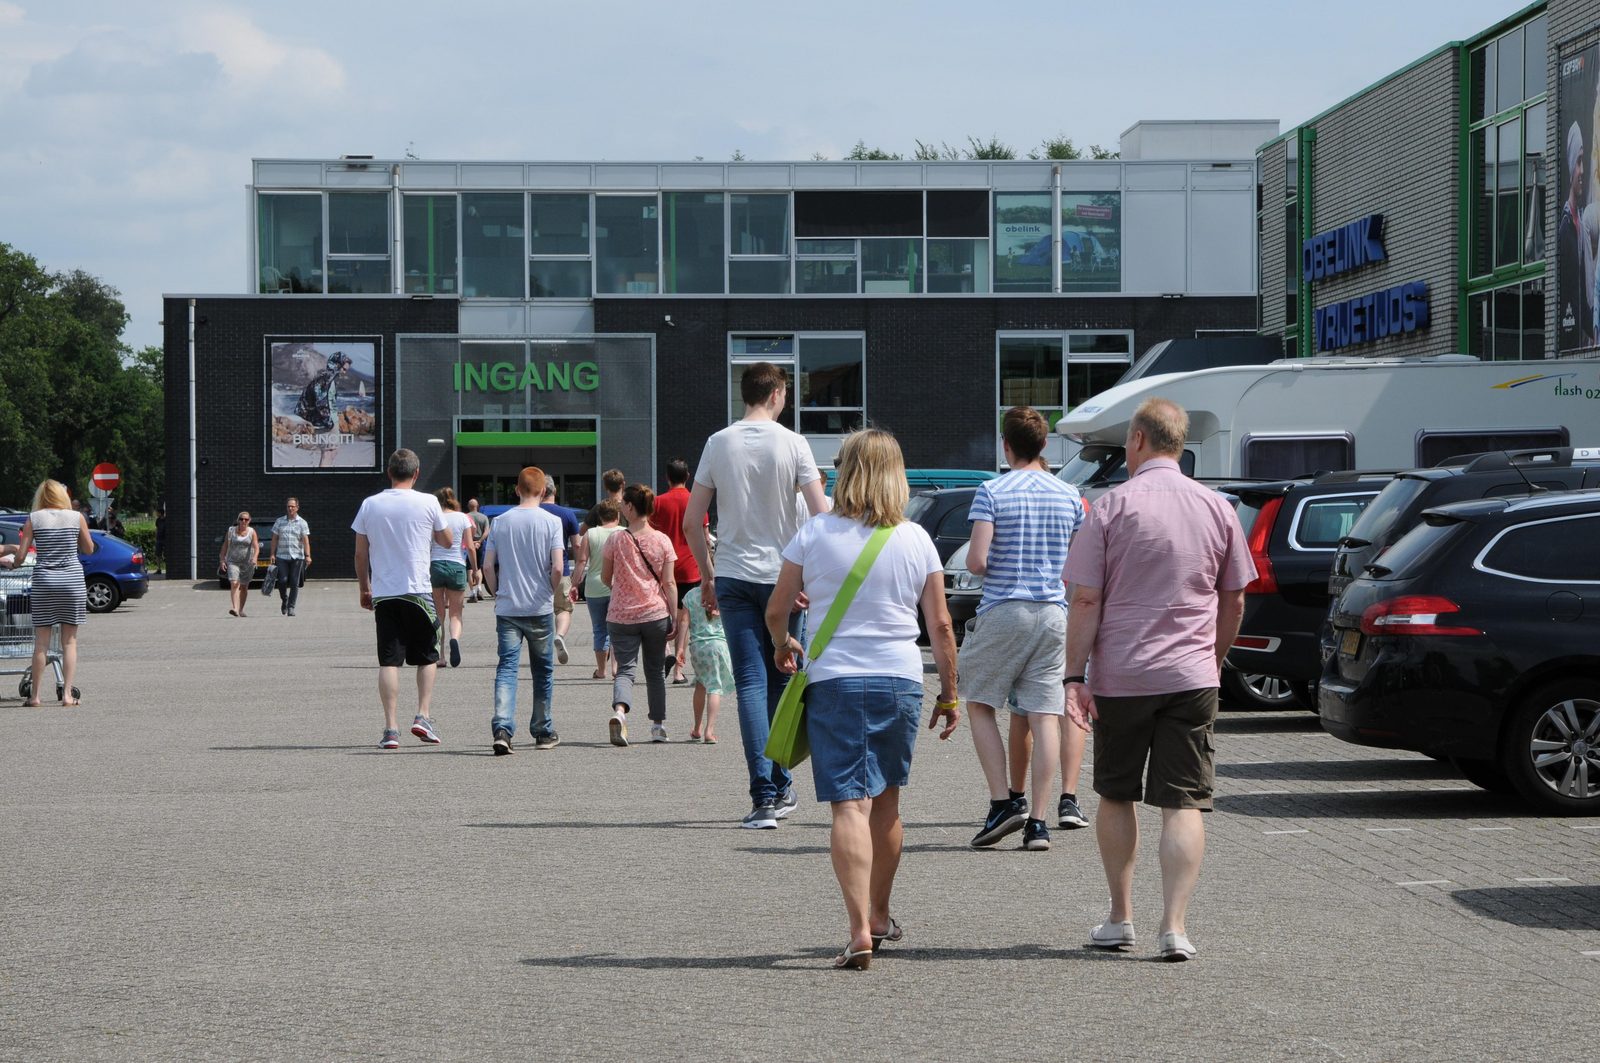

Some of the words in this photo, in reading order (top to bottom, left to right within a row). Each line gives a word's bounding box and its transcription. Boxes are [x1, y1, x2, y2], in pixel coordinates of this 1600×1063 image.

[1005, 225, 1040, 233] obelink
[1303, 215, 1383, 282] OBELINK
[1314, 281, 1426, 352] VRIJETIJDS
[453, 361, 600, 391] INGANG
[1554, 377, 1582, 396] flash
[293, 433, 354, 445] BRUNOTTI
